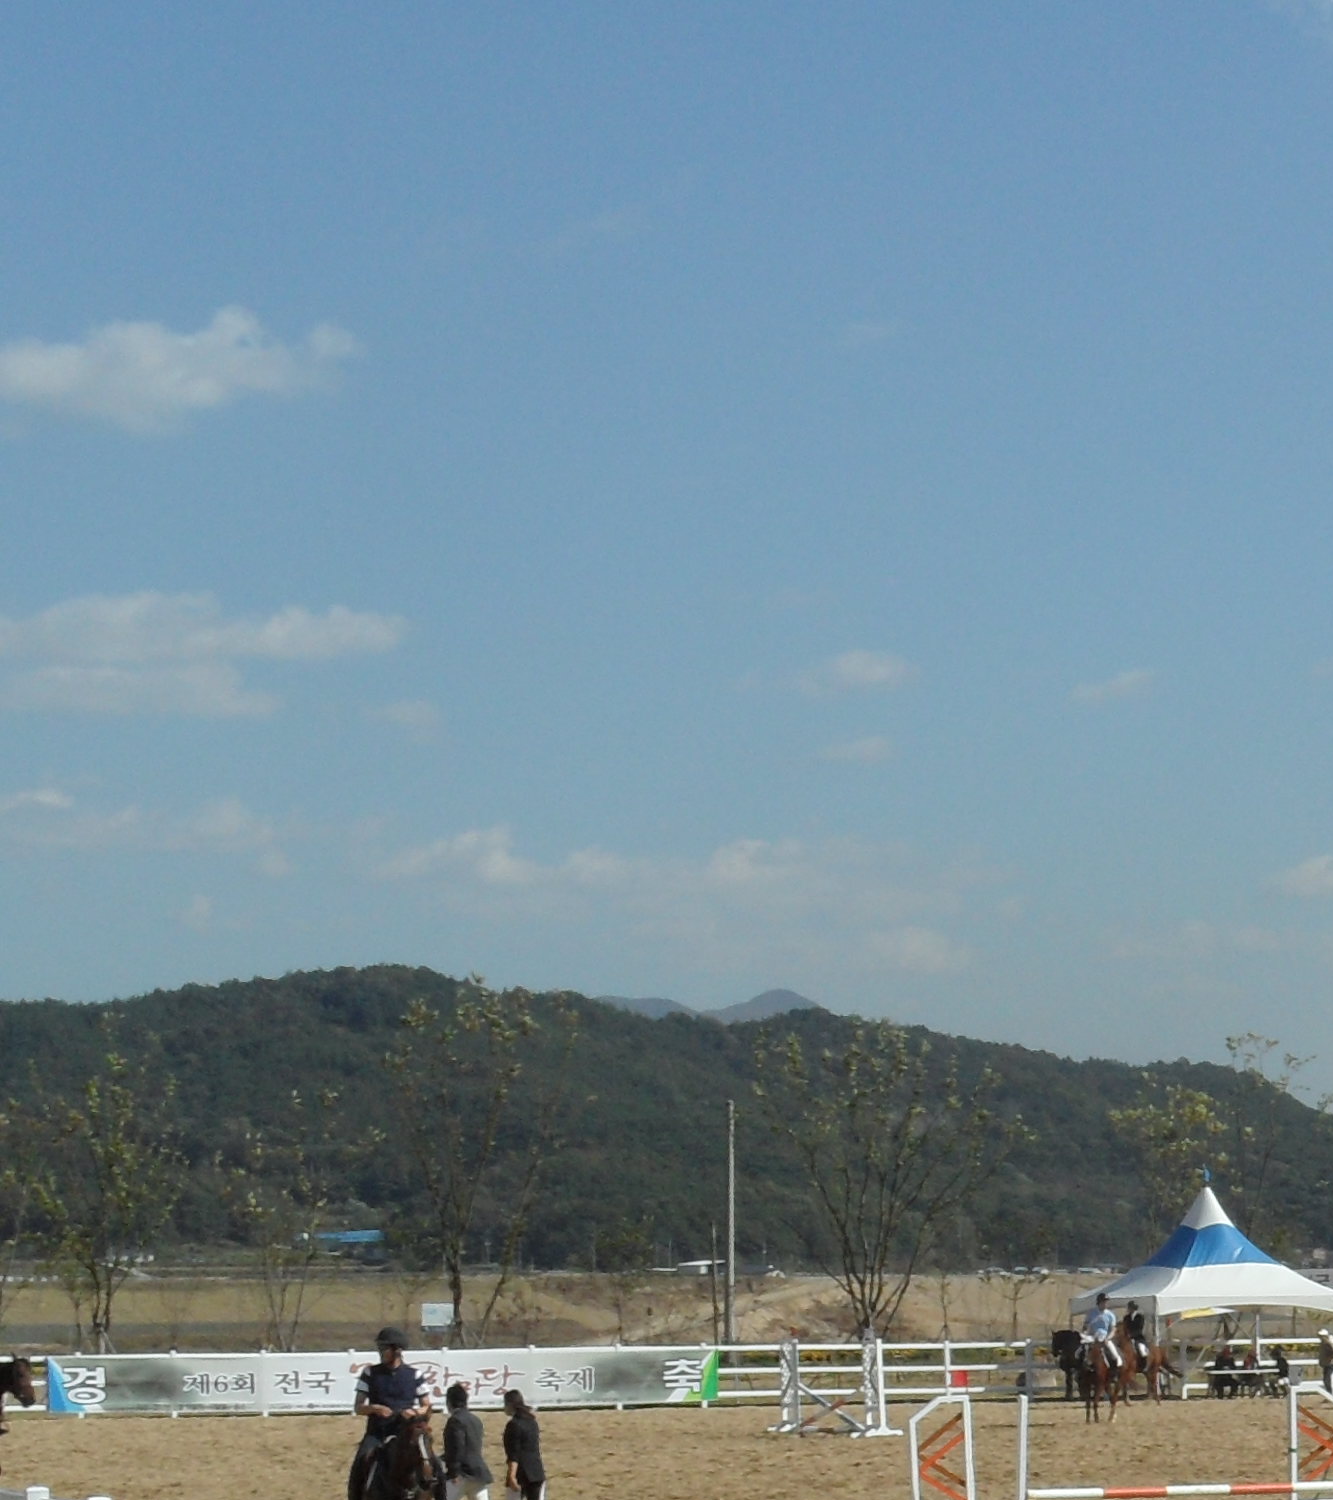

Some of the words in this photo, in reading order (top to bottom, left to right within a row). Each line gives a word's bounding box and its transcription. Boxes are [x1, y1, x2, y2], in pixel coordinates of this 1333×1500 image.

[63, 1366, 107, 1405] 경
[182, 1370, 257, 1395] 제6회
[274, 1370, 337, 1395] 전국
[534, 1366, 596, 1392] 축제
[663, 1357, 703, 1392] 축
